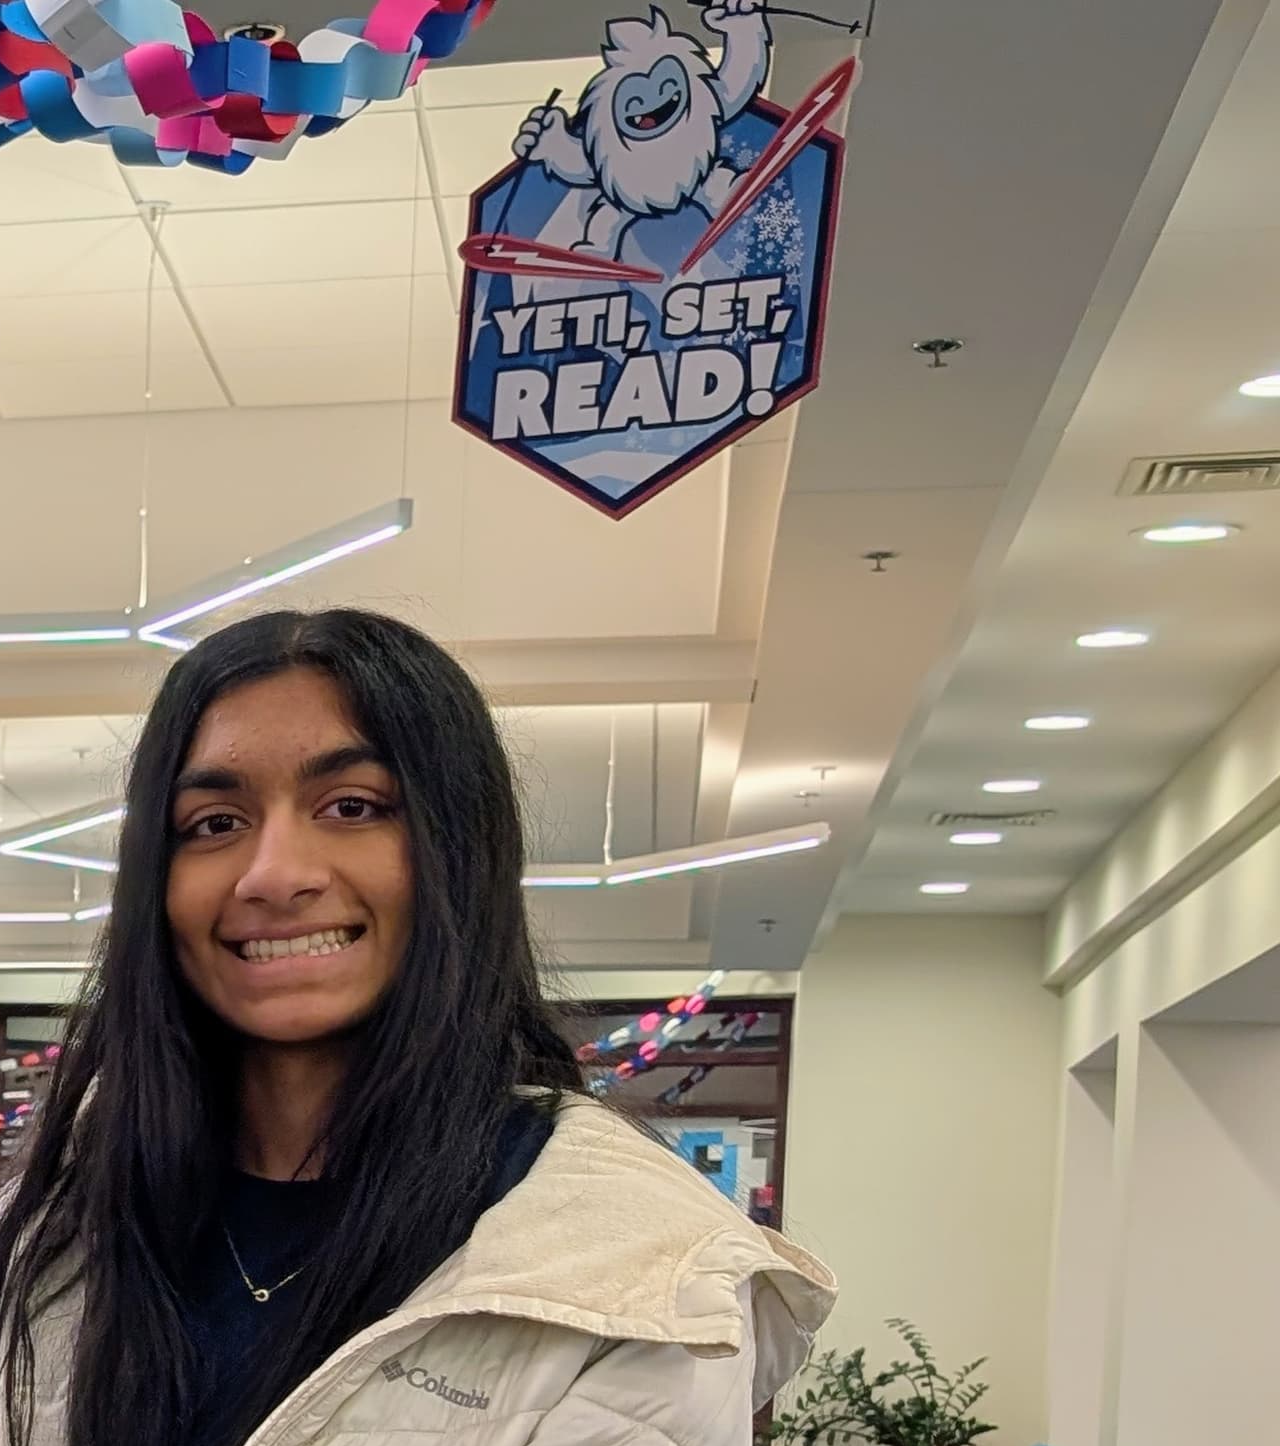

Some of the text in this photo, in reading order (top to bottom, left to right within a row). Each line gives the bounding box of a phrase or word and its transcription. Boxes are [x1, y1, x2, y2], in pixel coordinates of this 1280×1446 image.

[493, 277, 792, 355] YETI, SET,
[492, 342, 783, 440] READ!
[406, 1367, 490, 1410] Columbia
